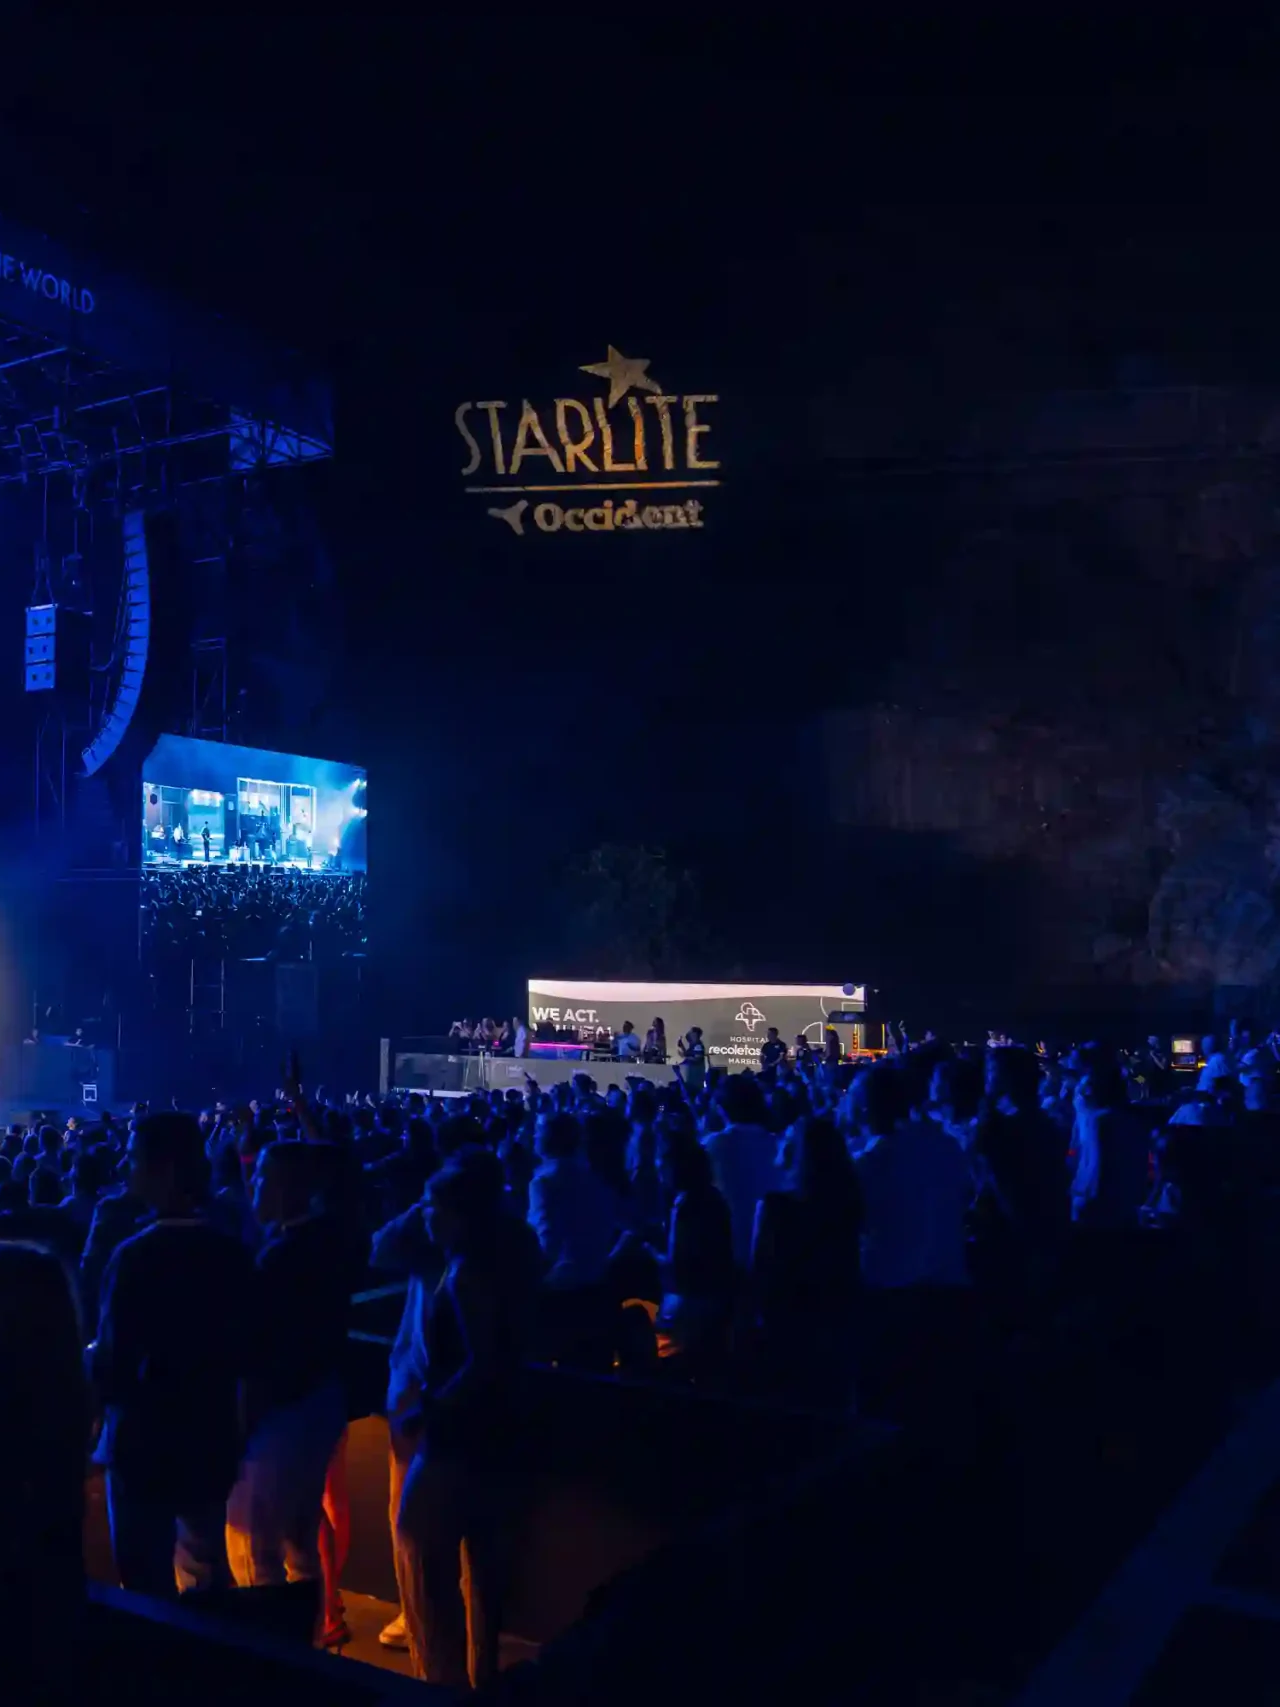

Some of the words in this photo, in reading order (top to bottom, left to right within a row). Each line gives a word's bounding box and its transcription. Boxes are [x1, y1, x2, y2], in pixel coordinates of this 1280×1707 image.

[19, 261, 96, 315] WORLD
[454, 394, 721, 476] STARLITE
[533, 499, 705, 532] Occident
[532, 1006, 561, 1021] WE
[563, 1008, 600, 1023] ACT.
[708, 1044, 761, 1056] recoletas
[729, 1036, 769, 1044] HOSPITAL
